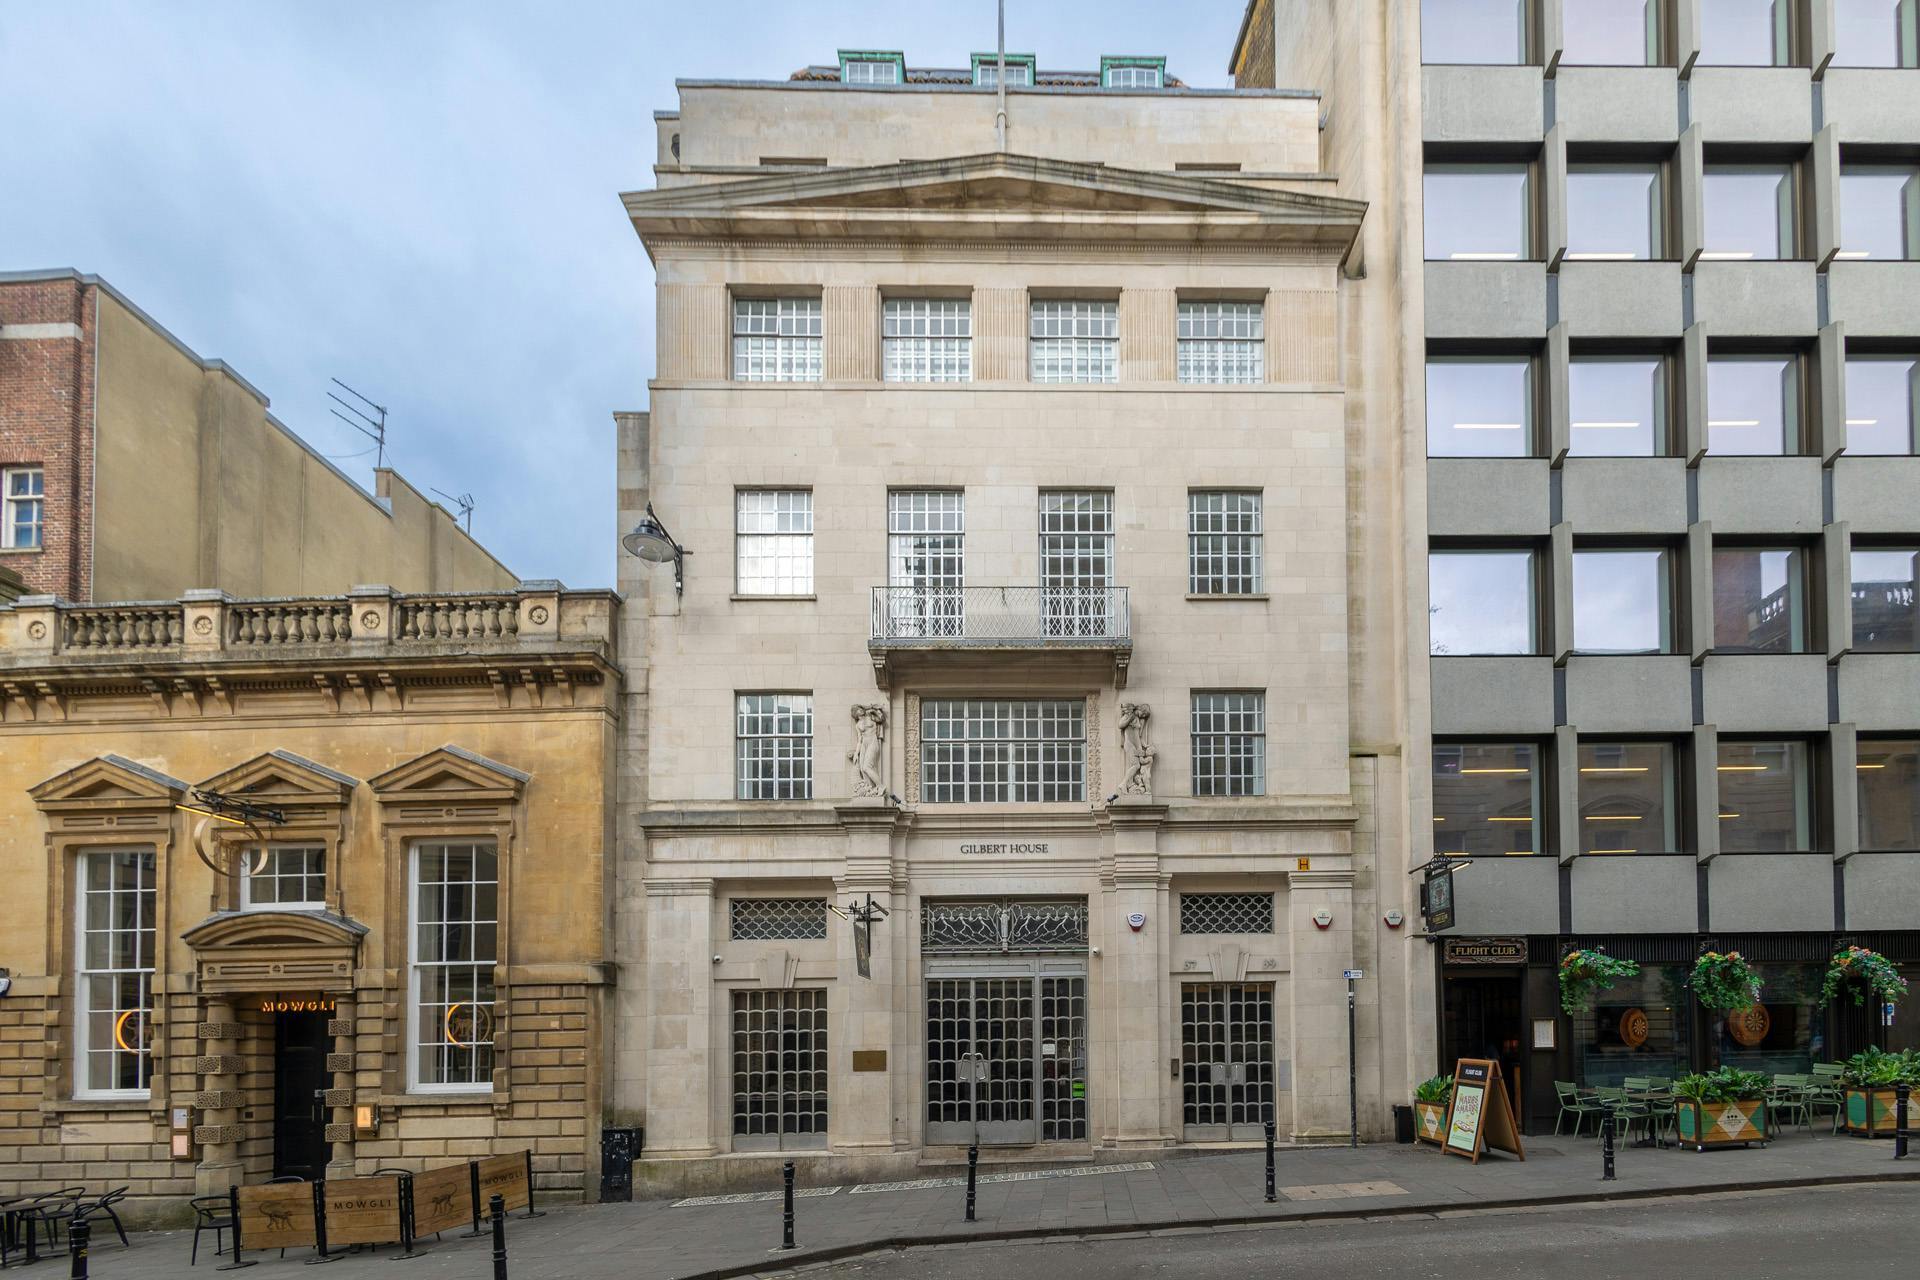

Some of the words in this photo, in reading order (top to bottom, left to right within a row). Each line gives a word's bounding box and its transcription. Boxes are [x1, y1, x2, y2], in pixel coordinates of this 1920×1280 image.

[960, 844, 1007, 854] GILBERT
[1010, 843, 1048, 853] HOUSE
[1299, 858, 1309, 870] H
[1455, 946, 1489, 955] FLIGHT
[1491, 946, 1516, 955] CLUB
[262, 1001, 335, 1012] MOWGLI
[483, 1171, 523, 1183] MOWGLI
[334, 1200, 391, 1210] MOWGLI
